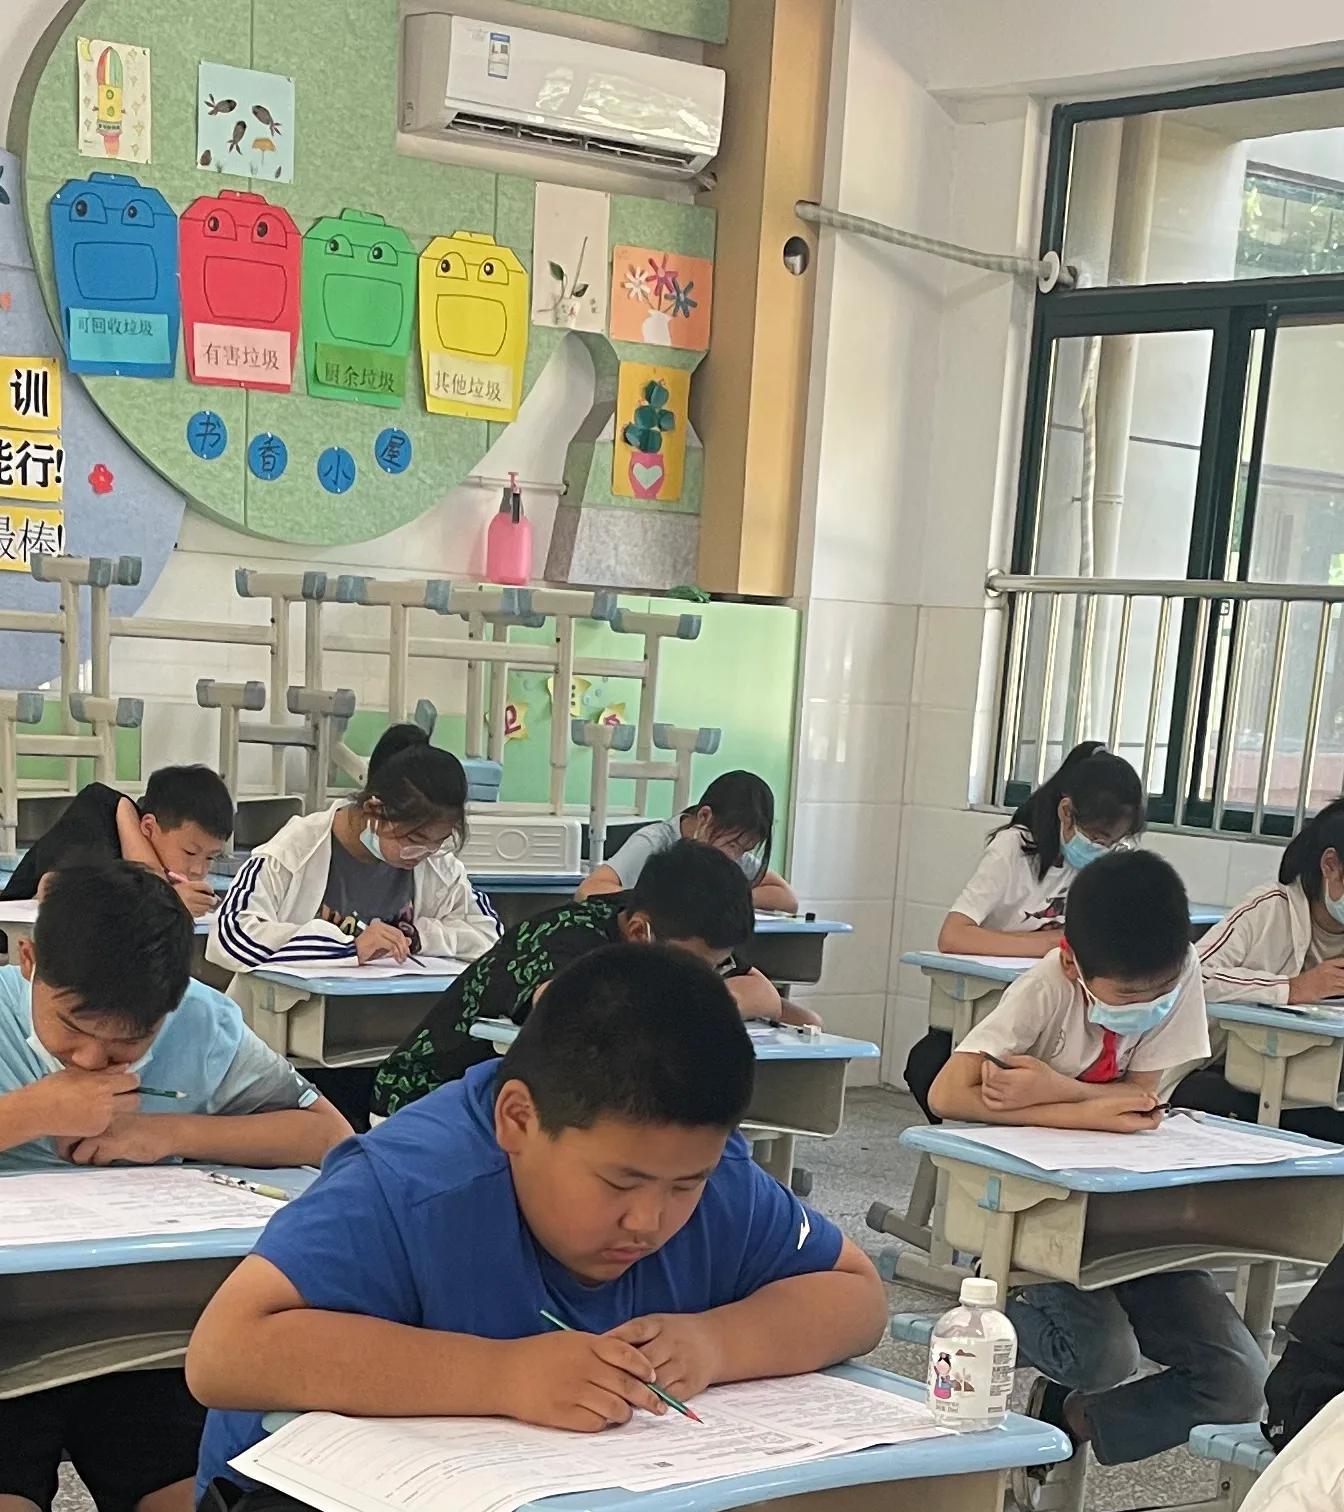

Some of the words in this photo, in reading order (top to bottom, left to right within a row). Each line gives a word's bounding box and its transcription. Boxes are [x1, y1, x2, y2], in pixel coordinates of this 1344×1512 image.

[78, 315, 154, 337] 可回收垃圾
[202, 342, 280, 371] 有害垃圾
[435, 369, 502, 402] 其他垃圾
